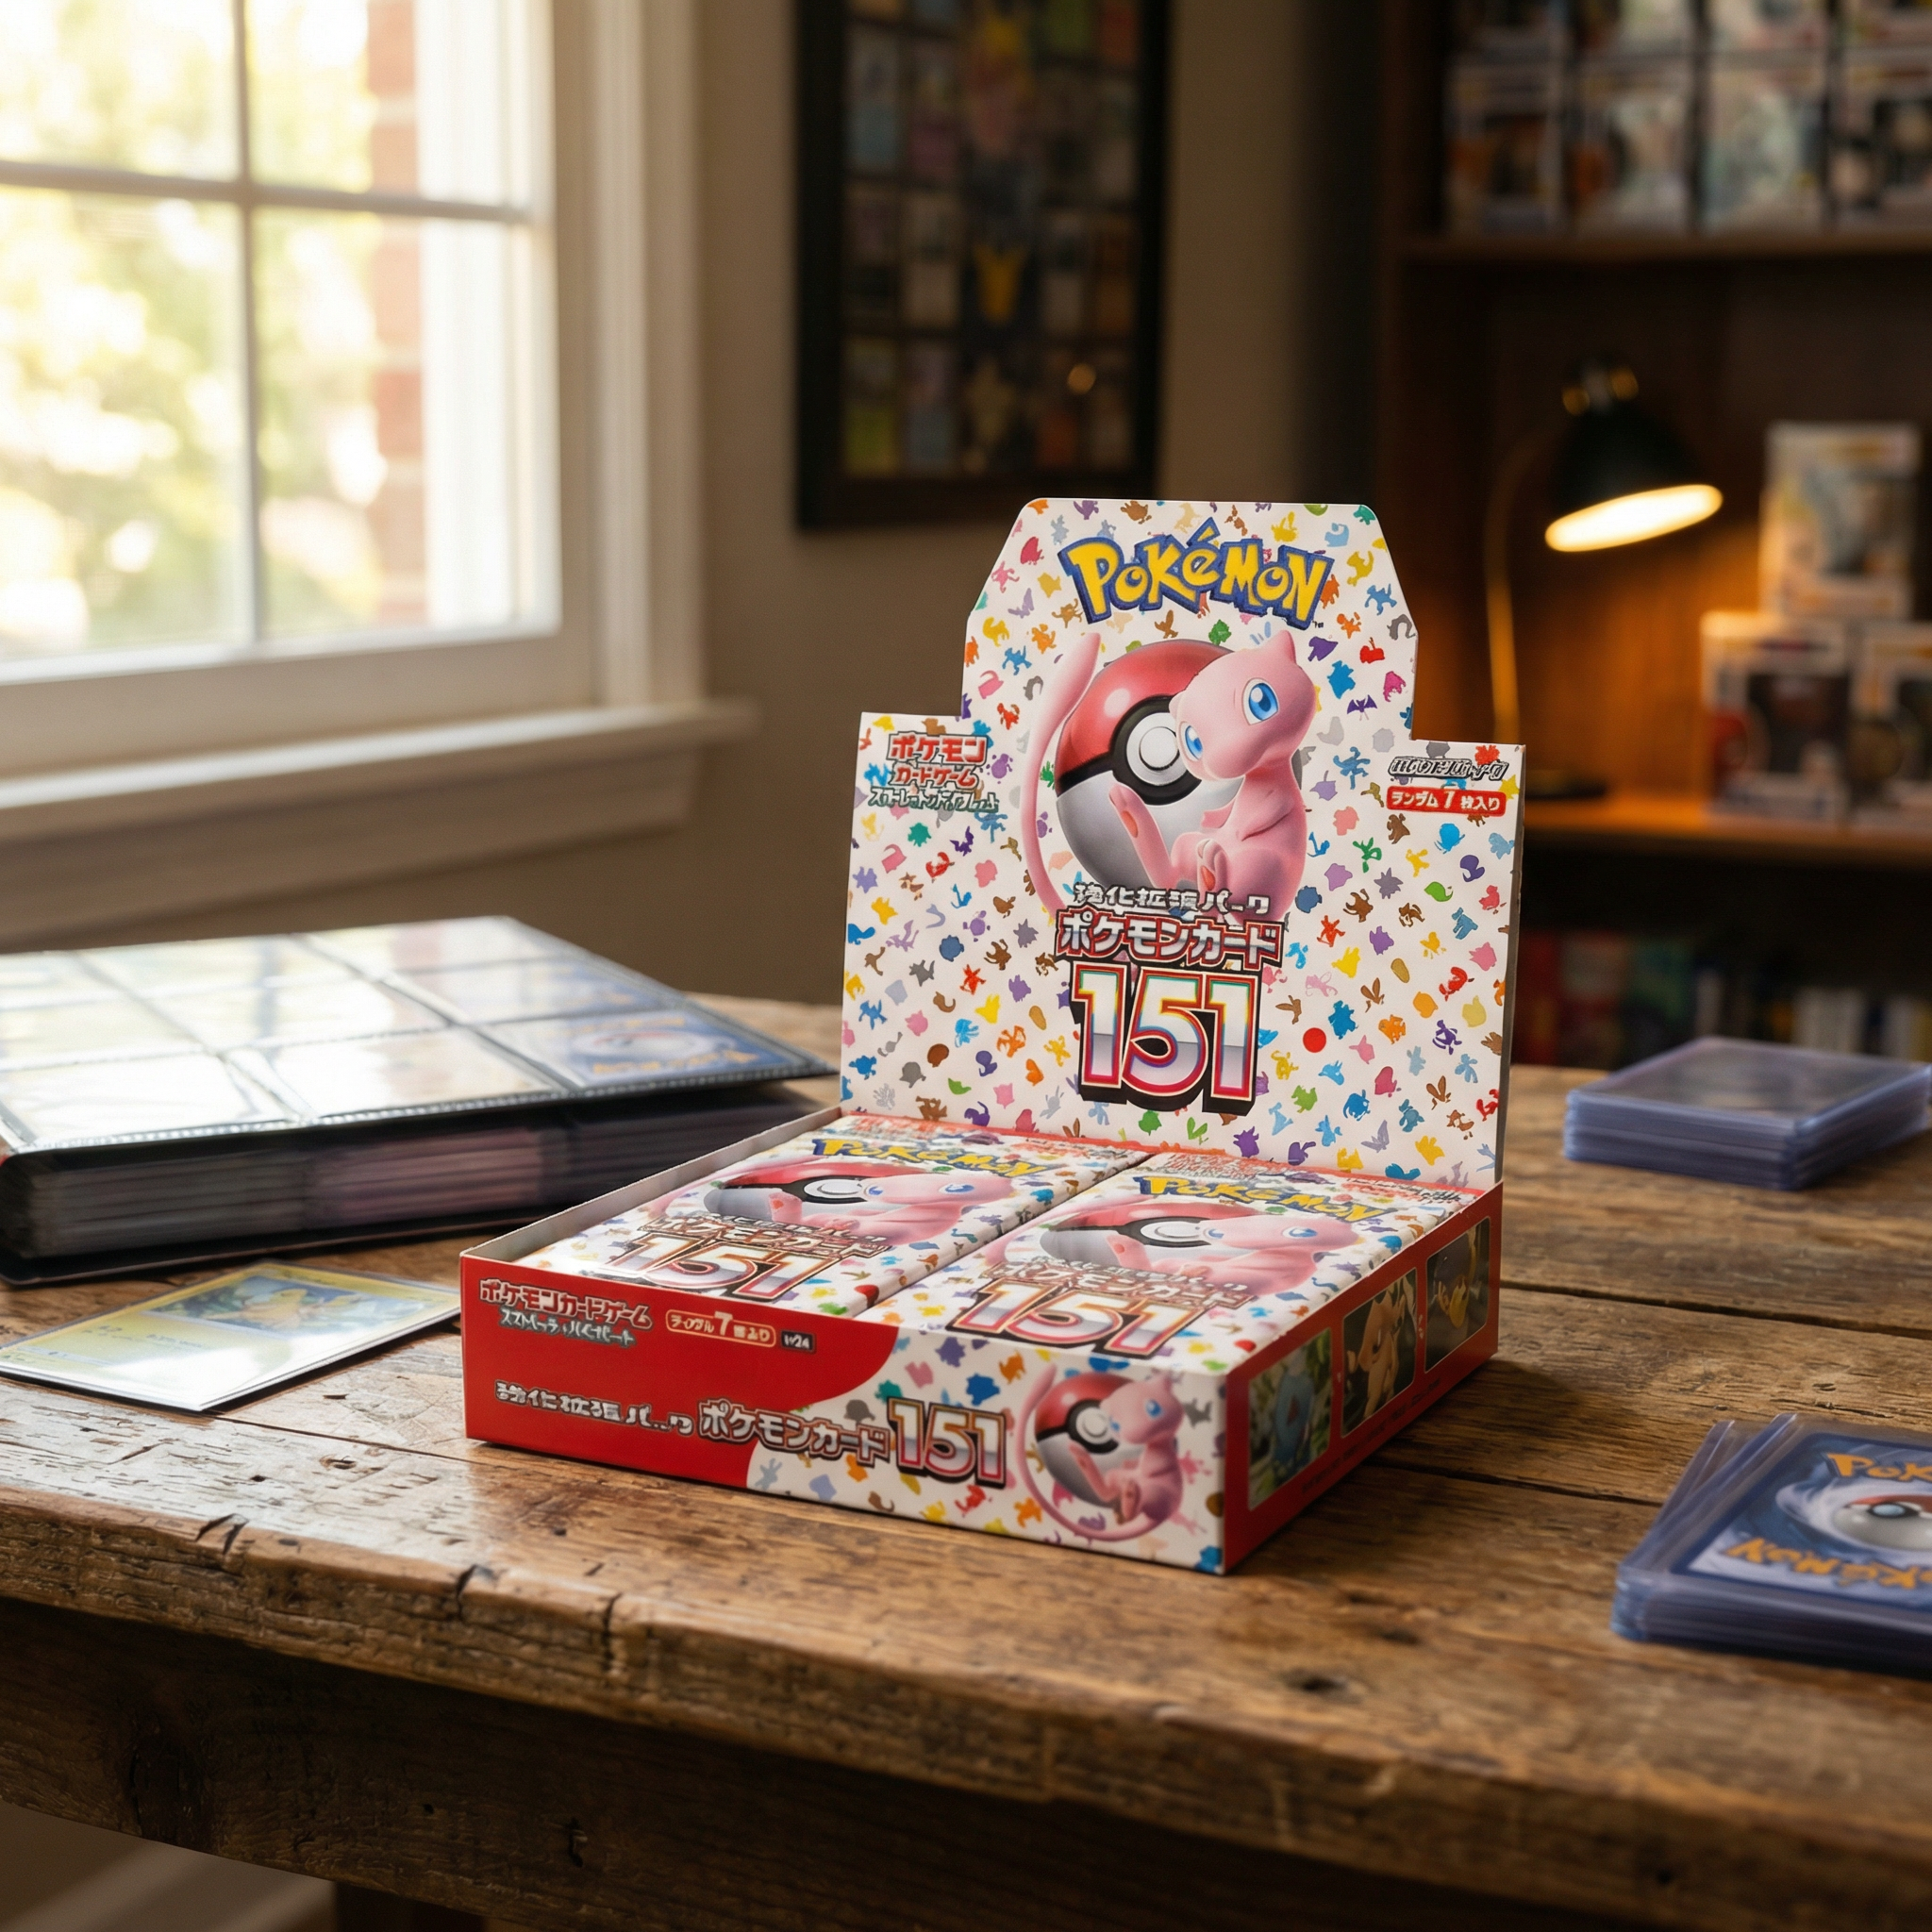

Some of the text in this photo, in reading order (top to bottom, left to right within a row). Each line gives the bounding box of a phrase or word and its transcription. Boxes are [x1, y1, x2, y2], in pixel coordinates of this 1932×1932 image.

[1055, 908, 1284, 971] ポケモンカード
[1071, 960, 1259, 1111] 151
[604, 1232, 841, 1301] 151
[946, 1277, 1206, 1359] 151
[697, 1398, 891, 1468] ポケモンカード
[887, 1396, 1007, 1489] 151
